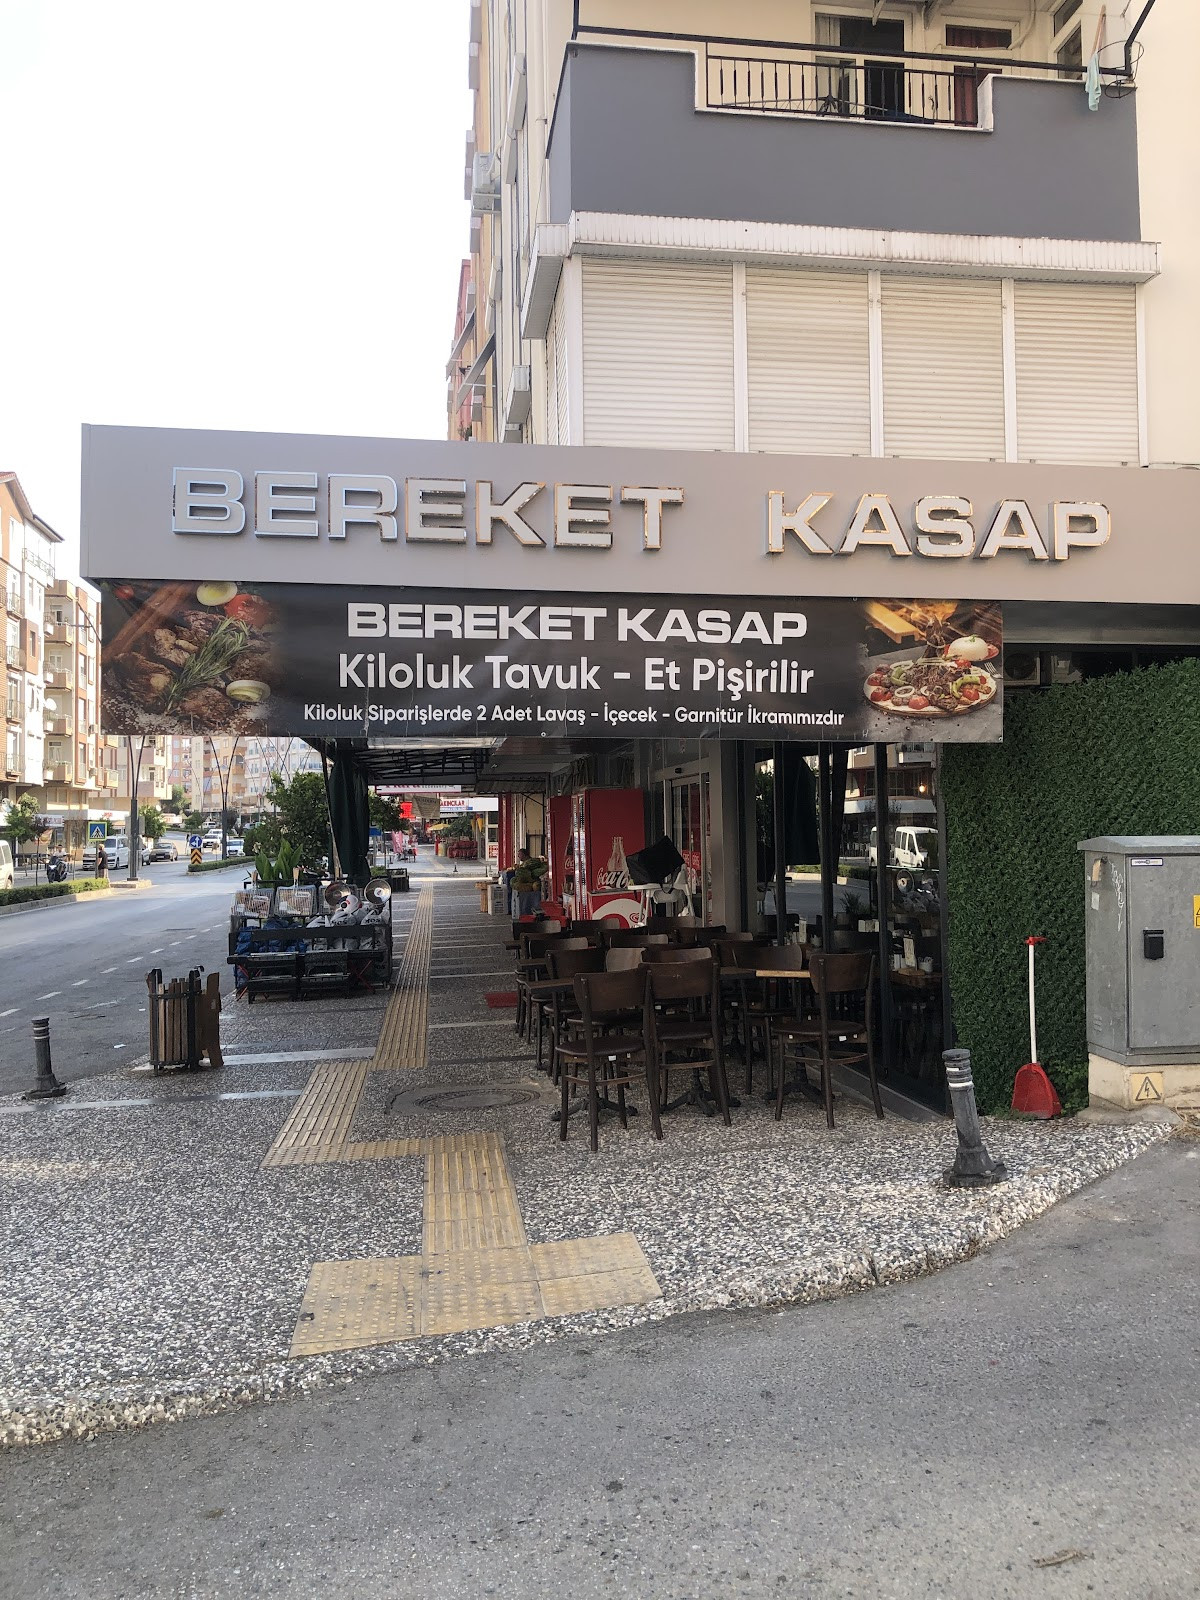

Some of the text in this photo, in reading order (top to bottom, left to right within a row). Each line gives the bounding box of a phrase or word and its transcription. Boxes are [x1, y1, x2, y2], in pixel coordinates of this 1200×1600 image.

[171, 466, 1111, 560] BEREKET KASAP
[347, 602, 807, 645] BEREKET KASAP
[339, 652, 814, 701] Kiloluk Tavuk - Et Pişirilir
[304, 704, 363, 721] Kiloluk
[368, 705, 473, 725] Siparişlerde
[476, 705, 487, 721] 2
[491, 705, 532, 721] Adet
[537, 706, 586, 725] Lavaş
[604, 702, 657, 725] İçecek
[674, 706, 743, 724] Garnitür
[747, 704, 845, 726] İkramımızdır
